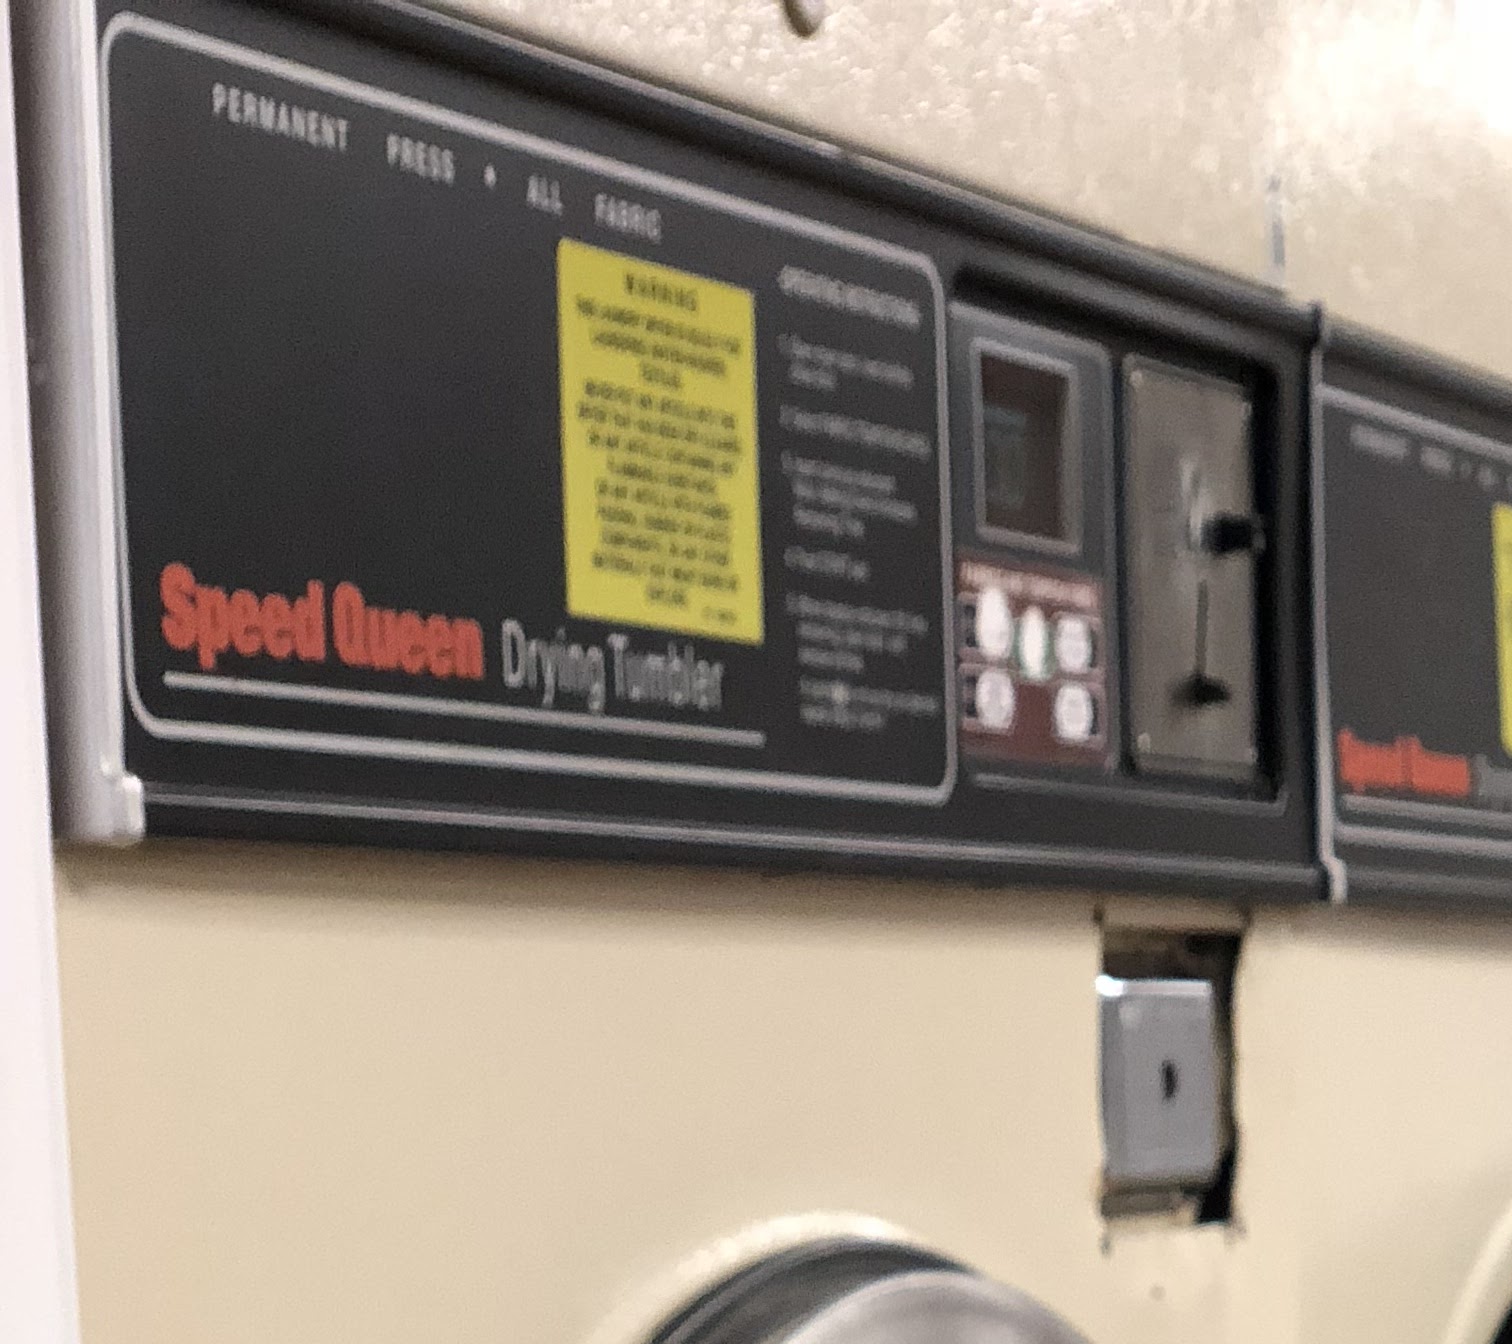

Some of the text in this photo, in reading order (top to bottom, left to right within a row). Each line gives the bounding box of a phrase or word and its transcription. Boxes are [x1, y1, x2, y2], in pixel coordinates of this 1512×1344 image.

[212, 82, 348, 152] PERMANENT
[387, 132, 455, 186] PRESS
[526, 172, 564, 217] ALL
[159, 561, 325, 670] Speed
[332, 580, 485, 681] Queen
[501, 618, 606, 712] Drying
[607, 633, 725, 712] Tumbler
